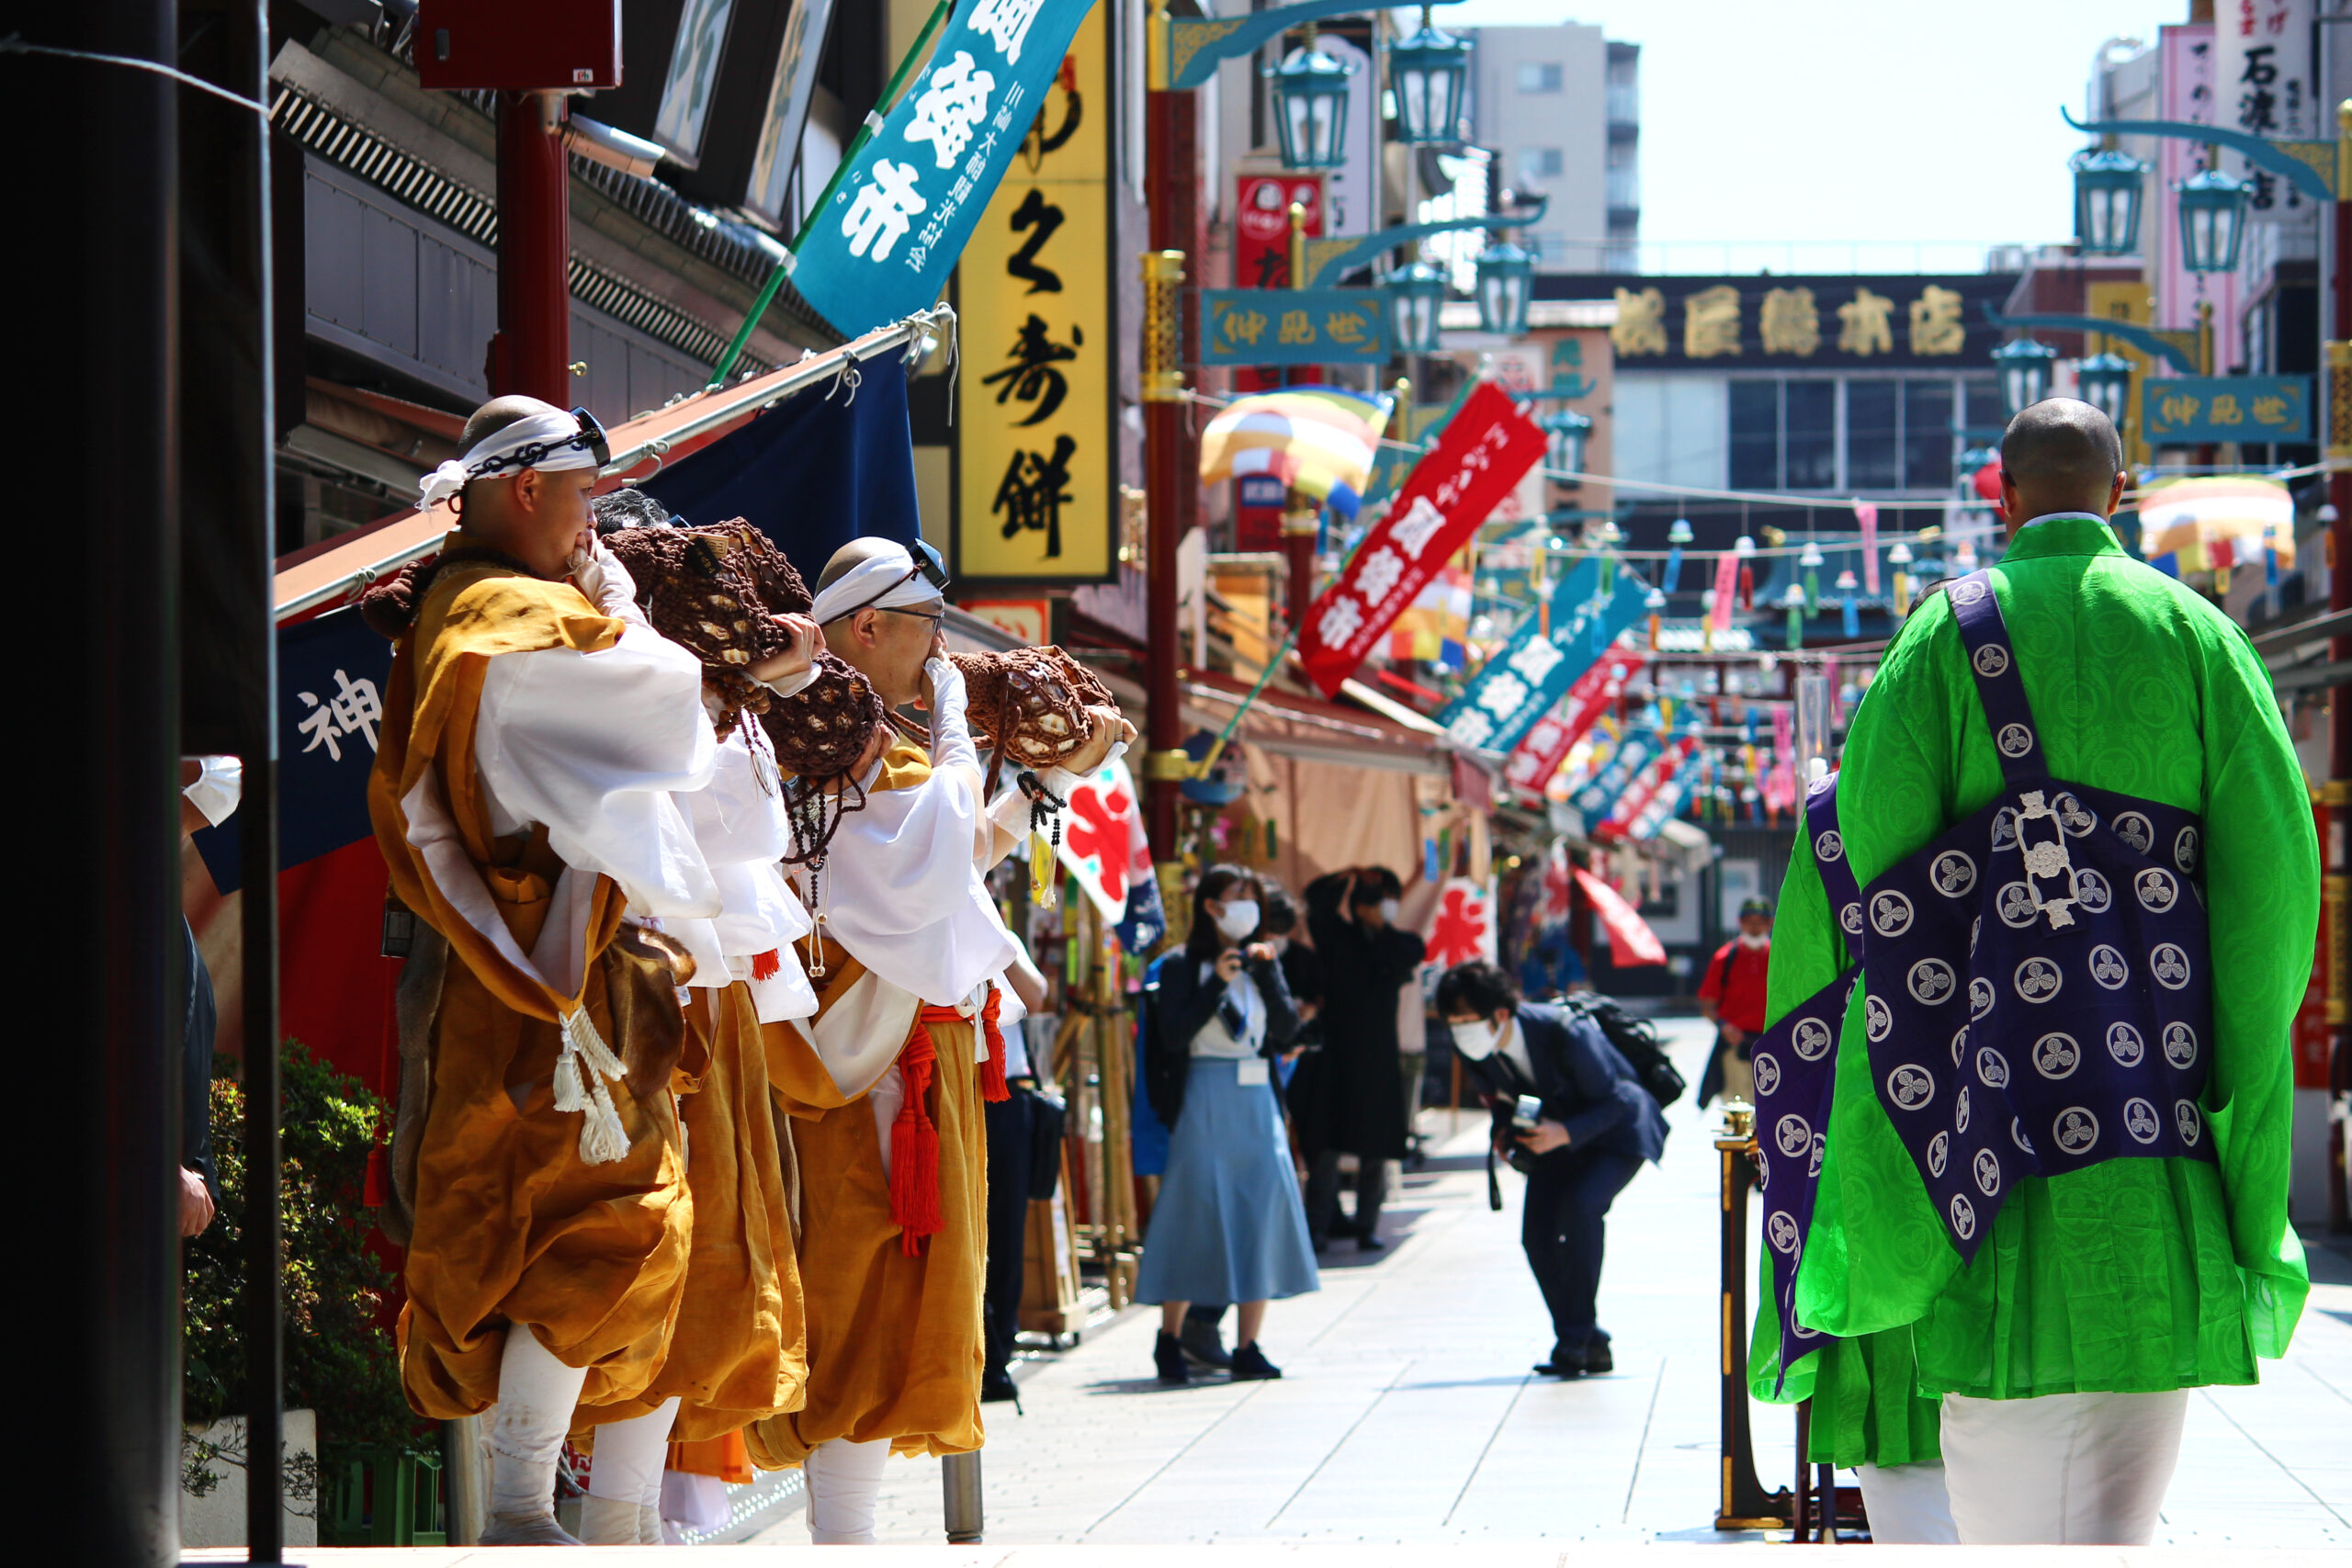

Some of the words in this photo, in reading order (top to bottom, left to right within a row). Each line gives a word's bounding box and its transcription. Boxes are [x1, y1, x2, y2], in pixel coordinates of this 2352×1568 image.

[1223, 309, 1367, 345] 仲見世
[2161, 393, 2289, 426] 仲見世
